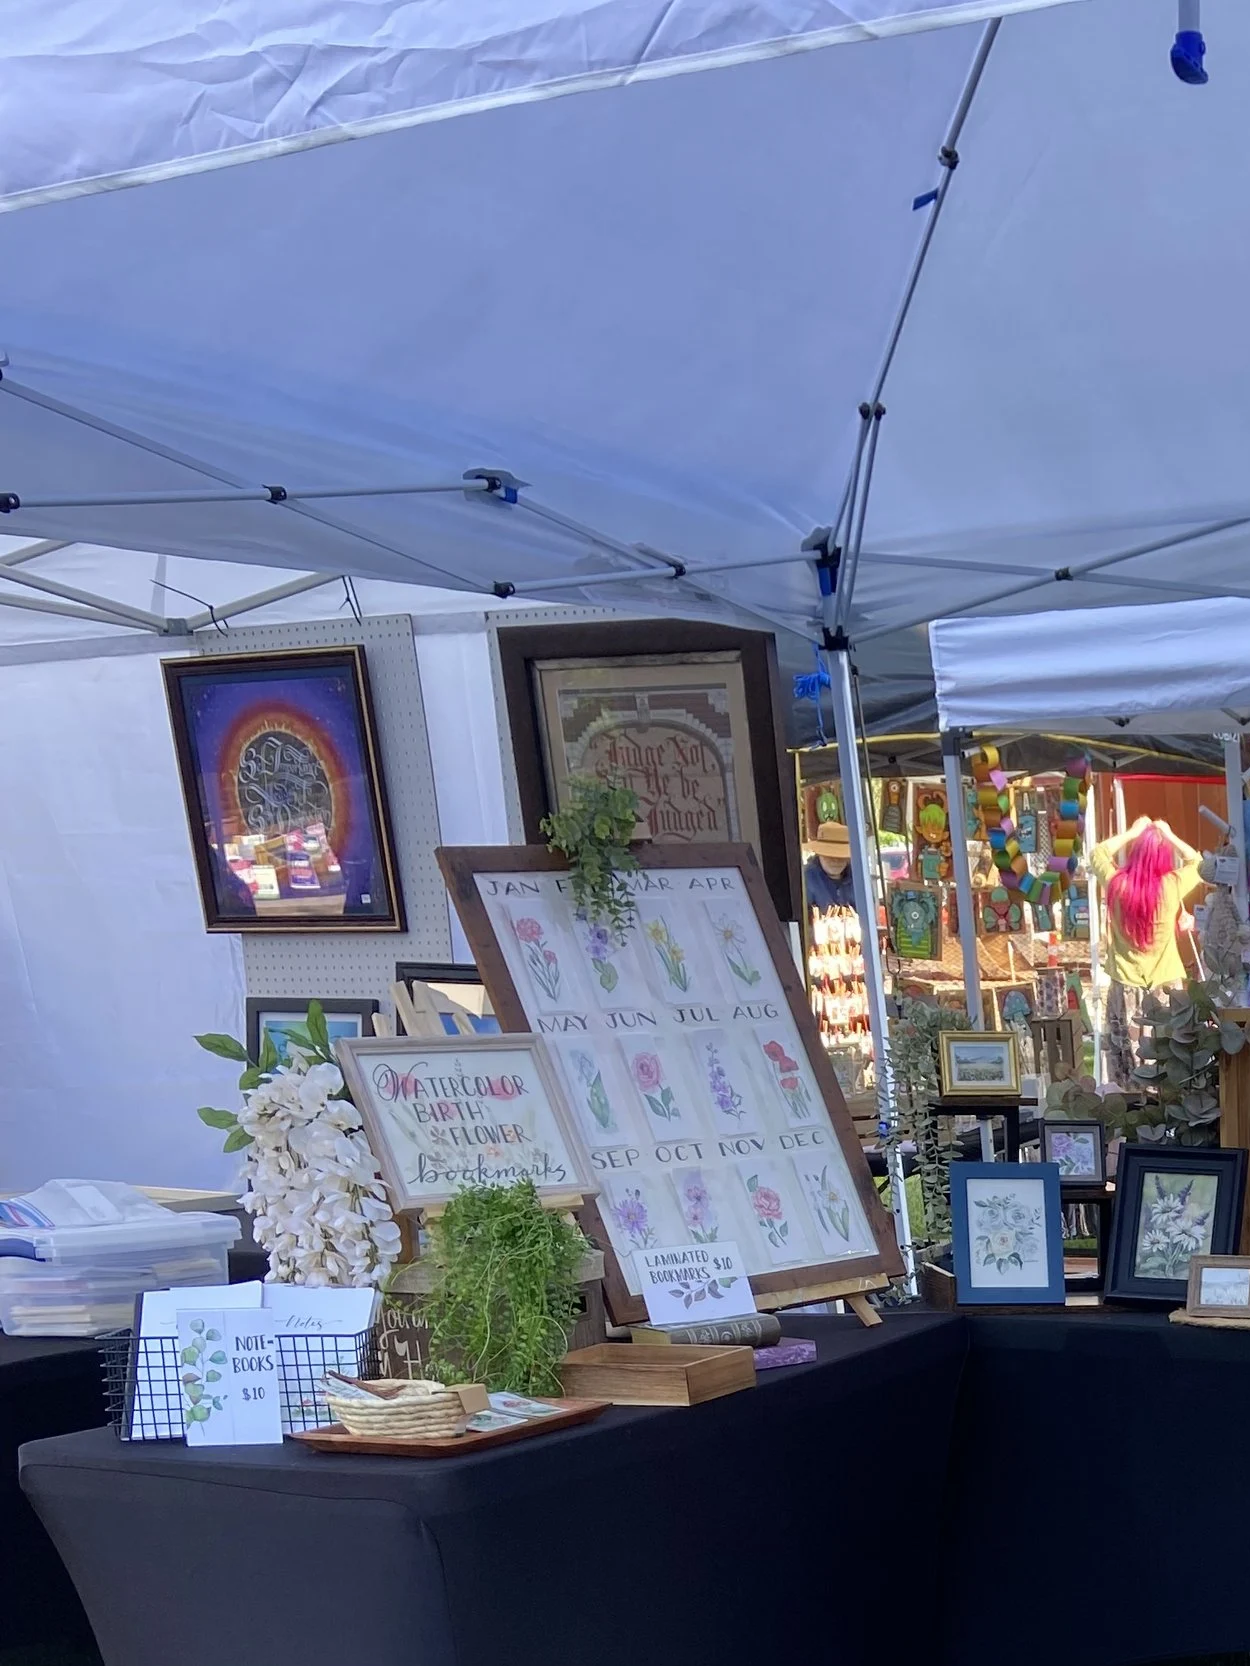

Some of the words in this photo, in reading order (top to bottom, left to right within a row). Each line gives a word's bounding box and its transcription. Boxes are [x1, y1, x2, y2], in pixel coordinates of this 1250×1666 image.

[487, 880, 540, 896] JAN
[625, 877, 674, 892] MAR
[689, 877, 736, 890] APR
[537, 1015, 588, 1033] MAY
[606, 1011, 657, 1030] JUN
[673, 1007, 720, 1023] JUL
[732, 1003, 779, 1020] AUG
[413, 1100, 485, 1123] BIRTH
[450, 1124, 532, 1146] FLOWER
[590, 1149, 641, 1170] SEP
[655, 1143, 705, 1163] OCT
[721, 1138, 766, 1157] NOV
[779, 1131, 825, 1150] DEC
[407, 1152, 567, 1185] bookmarks
[645, 1250, 709, 1268] LAMINATED
[713, 1257, 733, 1270] $10
[649, 1267, 710, 1284] BOOKMARKS
[235, 1334, 274, 1351] NOTE-
[232, 1355, 274, 1373] BOOKS
[242, 1387, 265, 1401] $10
